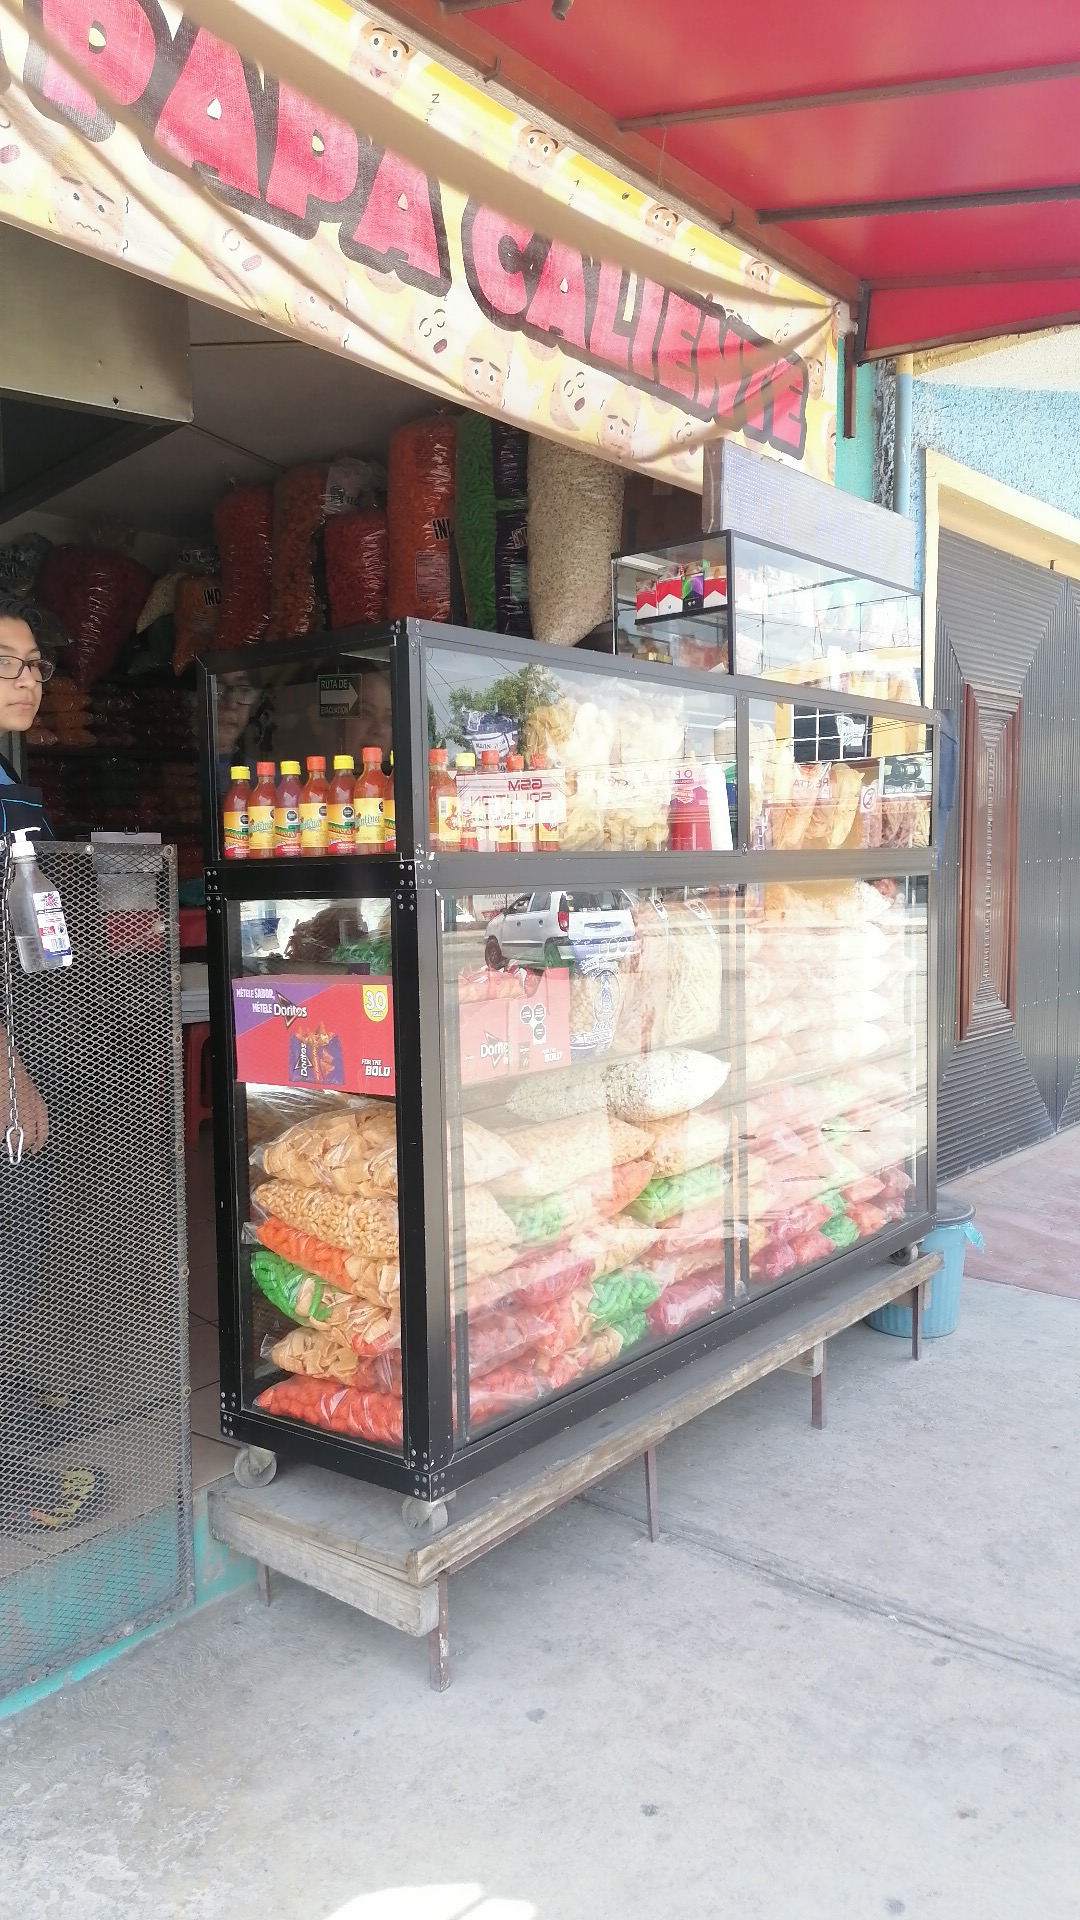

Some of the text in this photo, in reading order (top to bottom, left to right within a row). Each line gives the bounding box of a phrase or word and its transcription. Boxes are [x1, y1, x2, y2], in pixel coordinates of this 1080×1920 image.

[462, 200, 810, 459] CALIENTE
[320, 679, 348, 689] RUTA DE
[365, 990, 386, 1010] 30
[273, 1003, 307, 1017] Doritos
[300, 1043, 308, 1077] Doritos
[361, 1058, 371, 1066] FOR
[365, 1065, 391, 1078] BOLD
